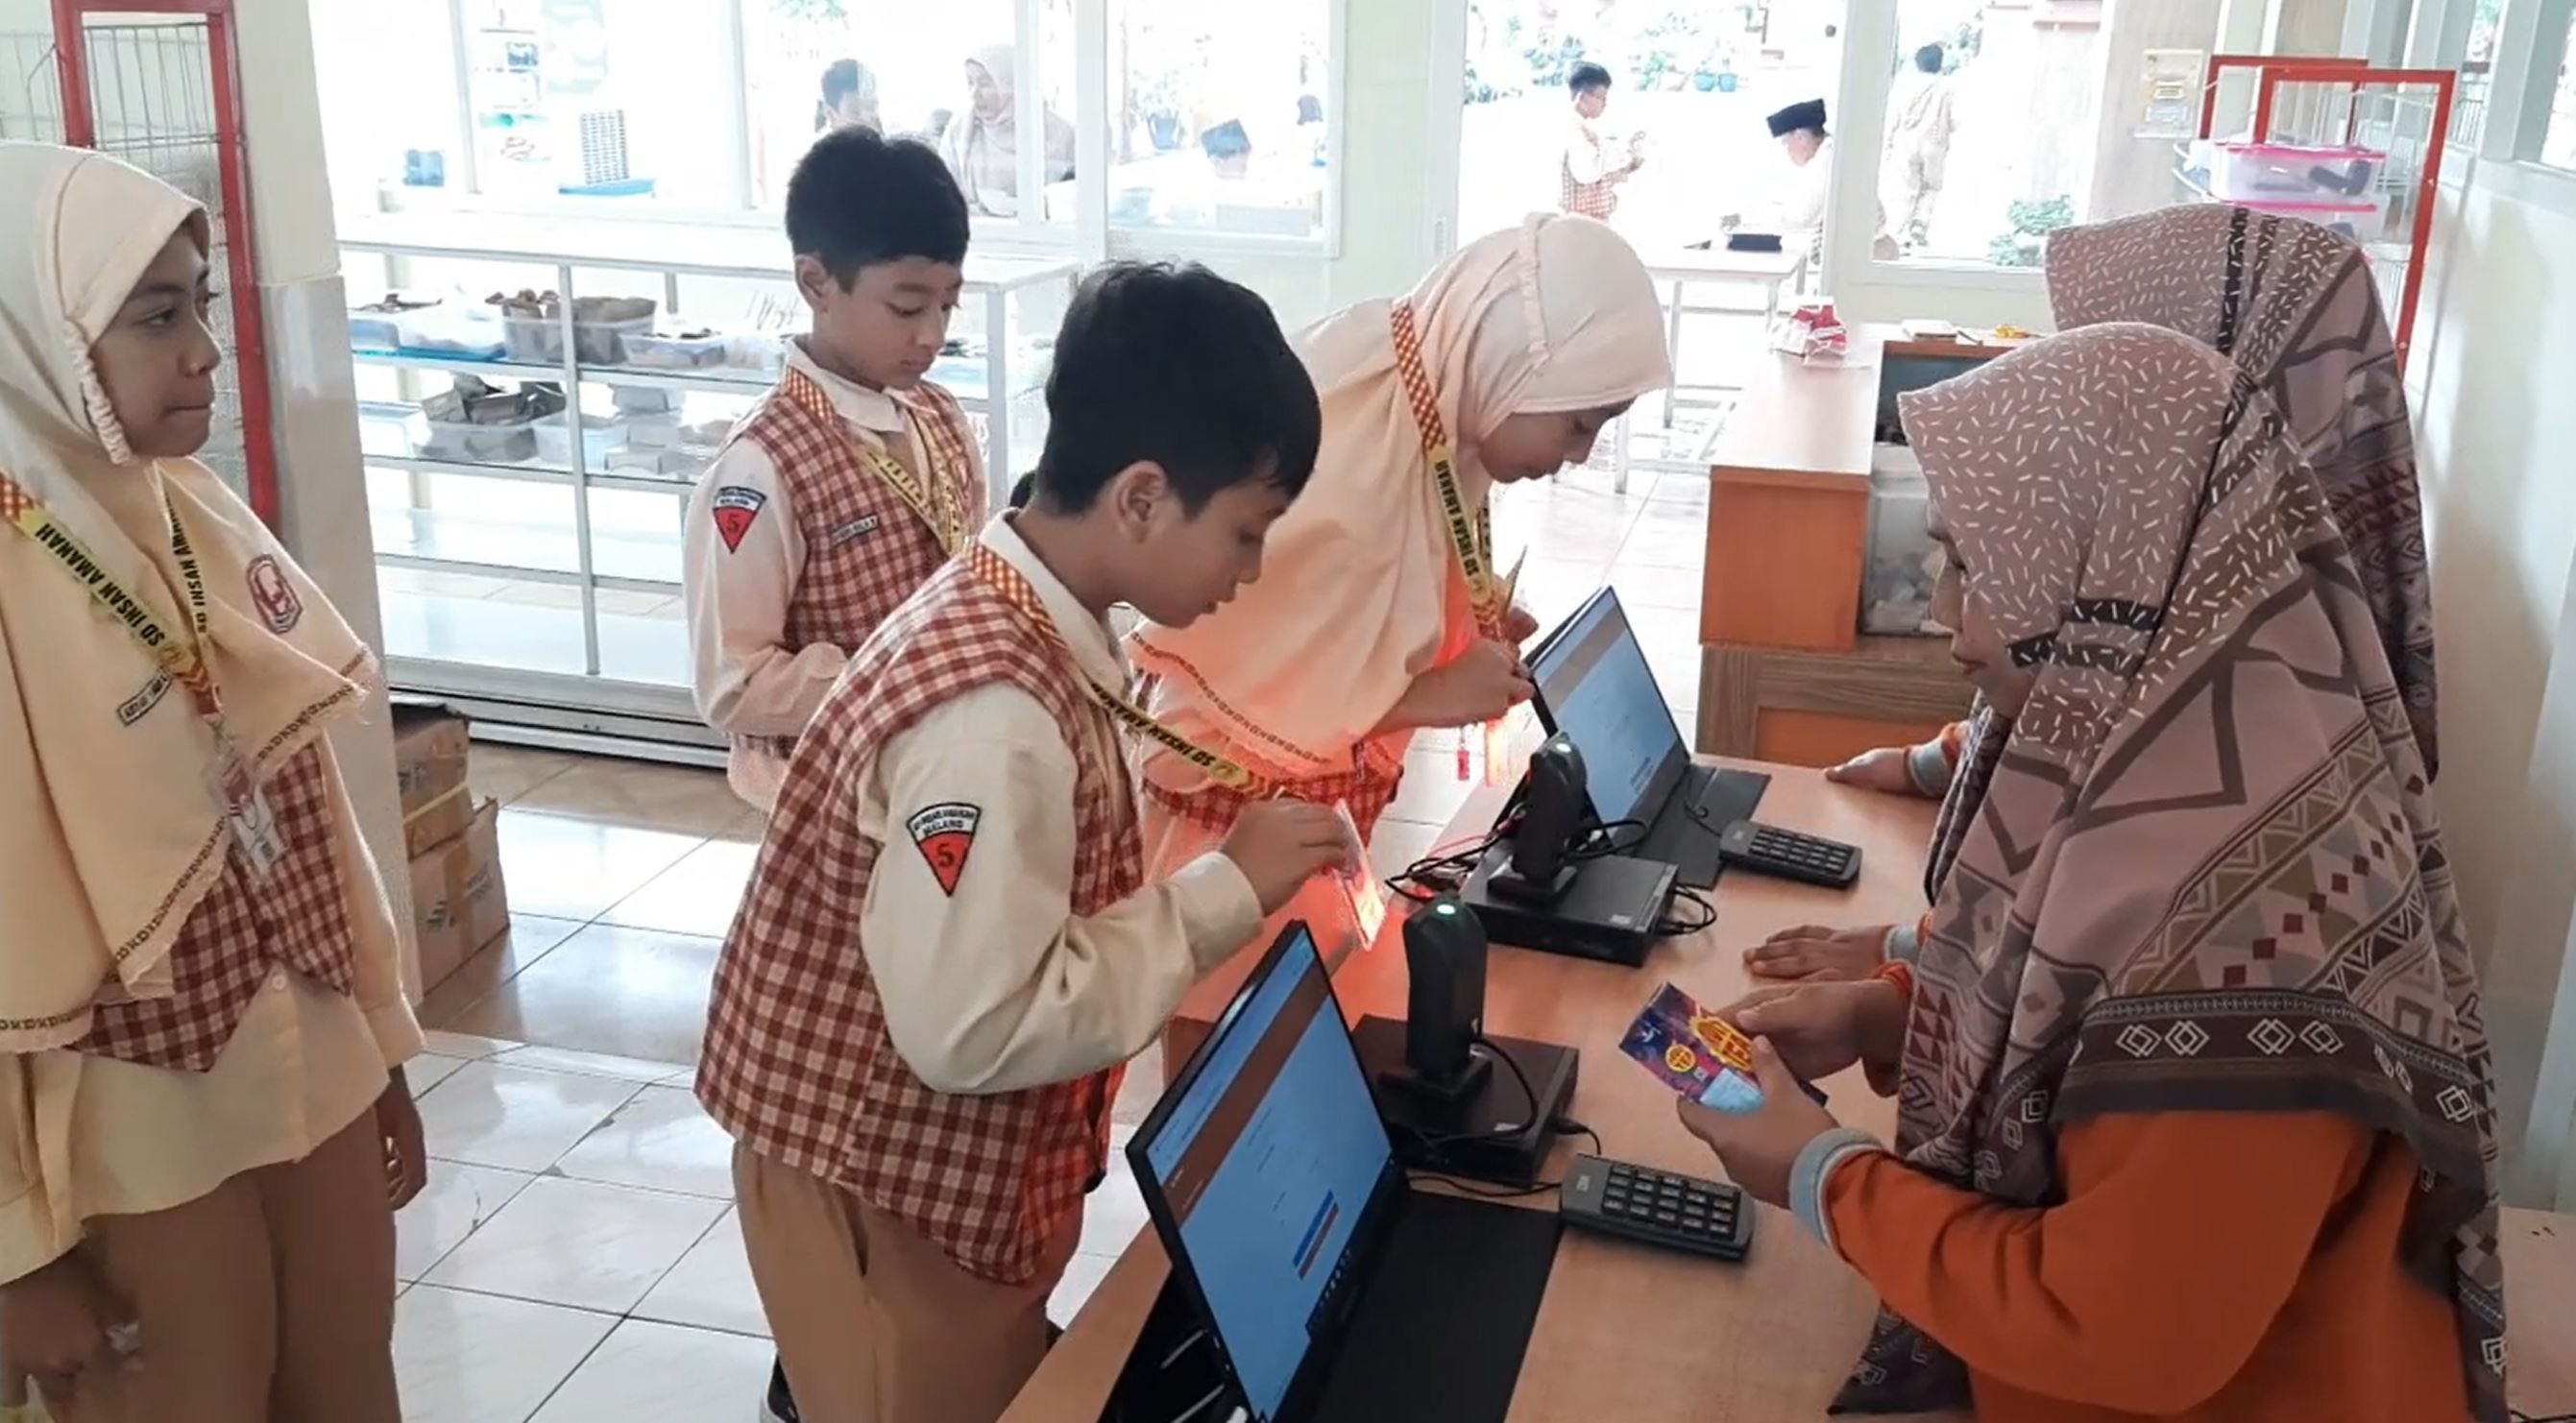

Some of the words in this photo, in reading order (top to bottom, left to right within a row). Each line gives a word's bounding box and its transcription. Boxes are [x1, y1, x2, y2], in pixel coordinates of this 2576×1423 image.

[726, 513, 740, 533] 5
[35, 522, 107, 586] AMANAH
[1463, 557, 1480, 577] SD
[178, 559, 207, 607] INSAN
[97, 581, 148, 628] INSAN
[138, 622, 166, 647] SD
[1148, 723, 1197, 756] INSAN
[1190, 749, 1217, 767] SD
[936, 842, 956, 869] 5
